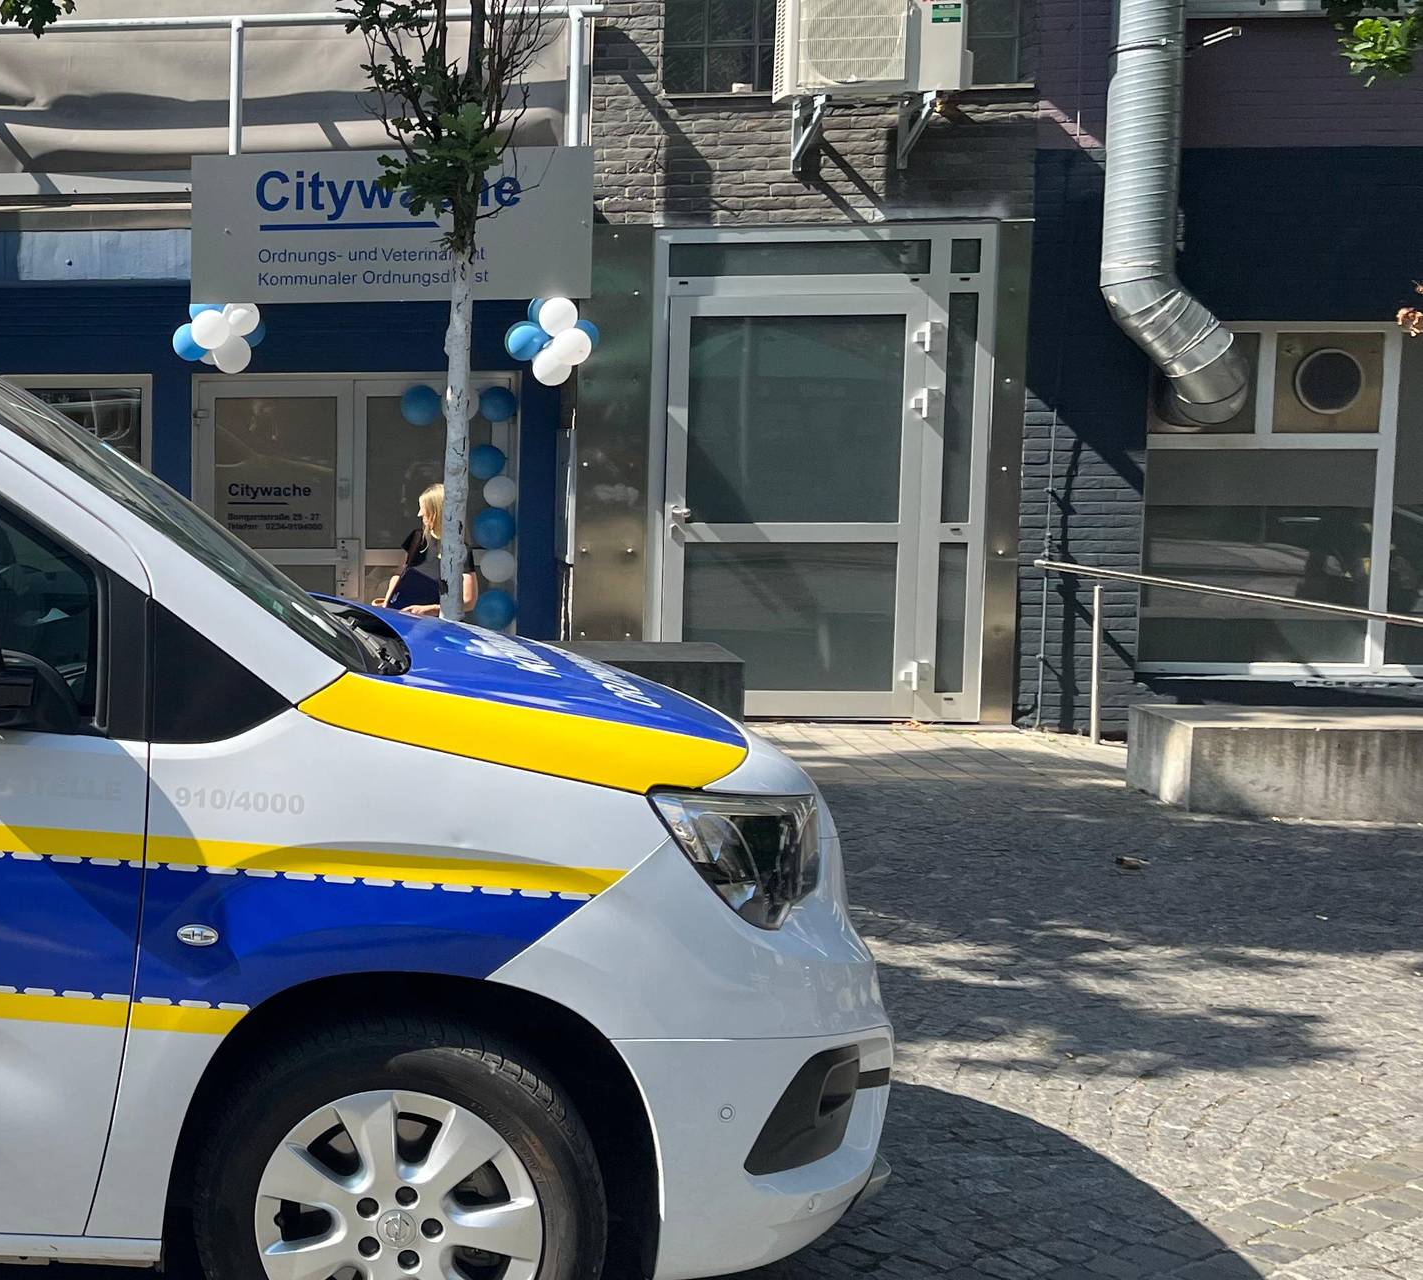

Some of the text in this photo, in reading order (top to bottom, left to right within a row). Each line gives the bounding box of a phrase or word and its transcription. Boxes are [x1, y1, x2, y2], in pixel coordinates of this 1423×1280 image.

[255, 170, 521, 221] Citywe
[258, 247, 485, 266] Ordnungs- und Veterinärt
[258, 271, 357, 286] Kommunaler
[228, 483, 312, 500] Citywache
[175, 786, 305, 816] 910/4000
